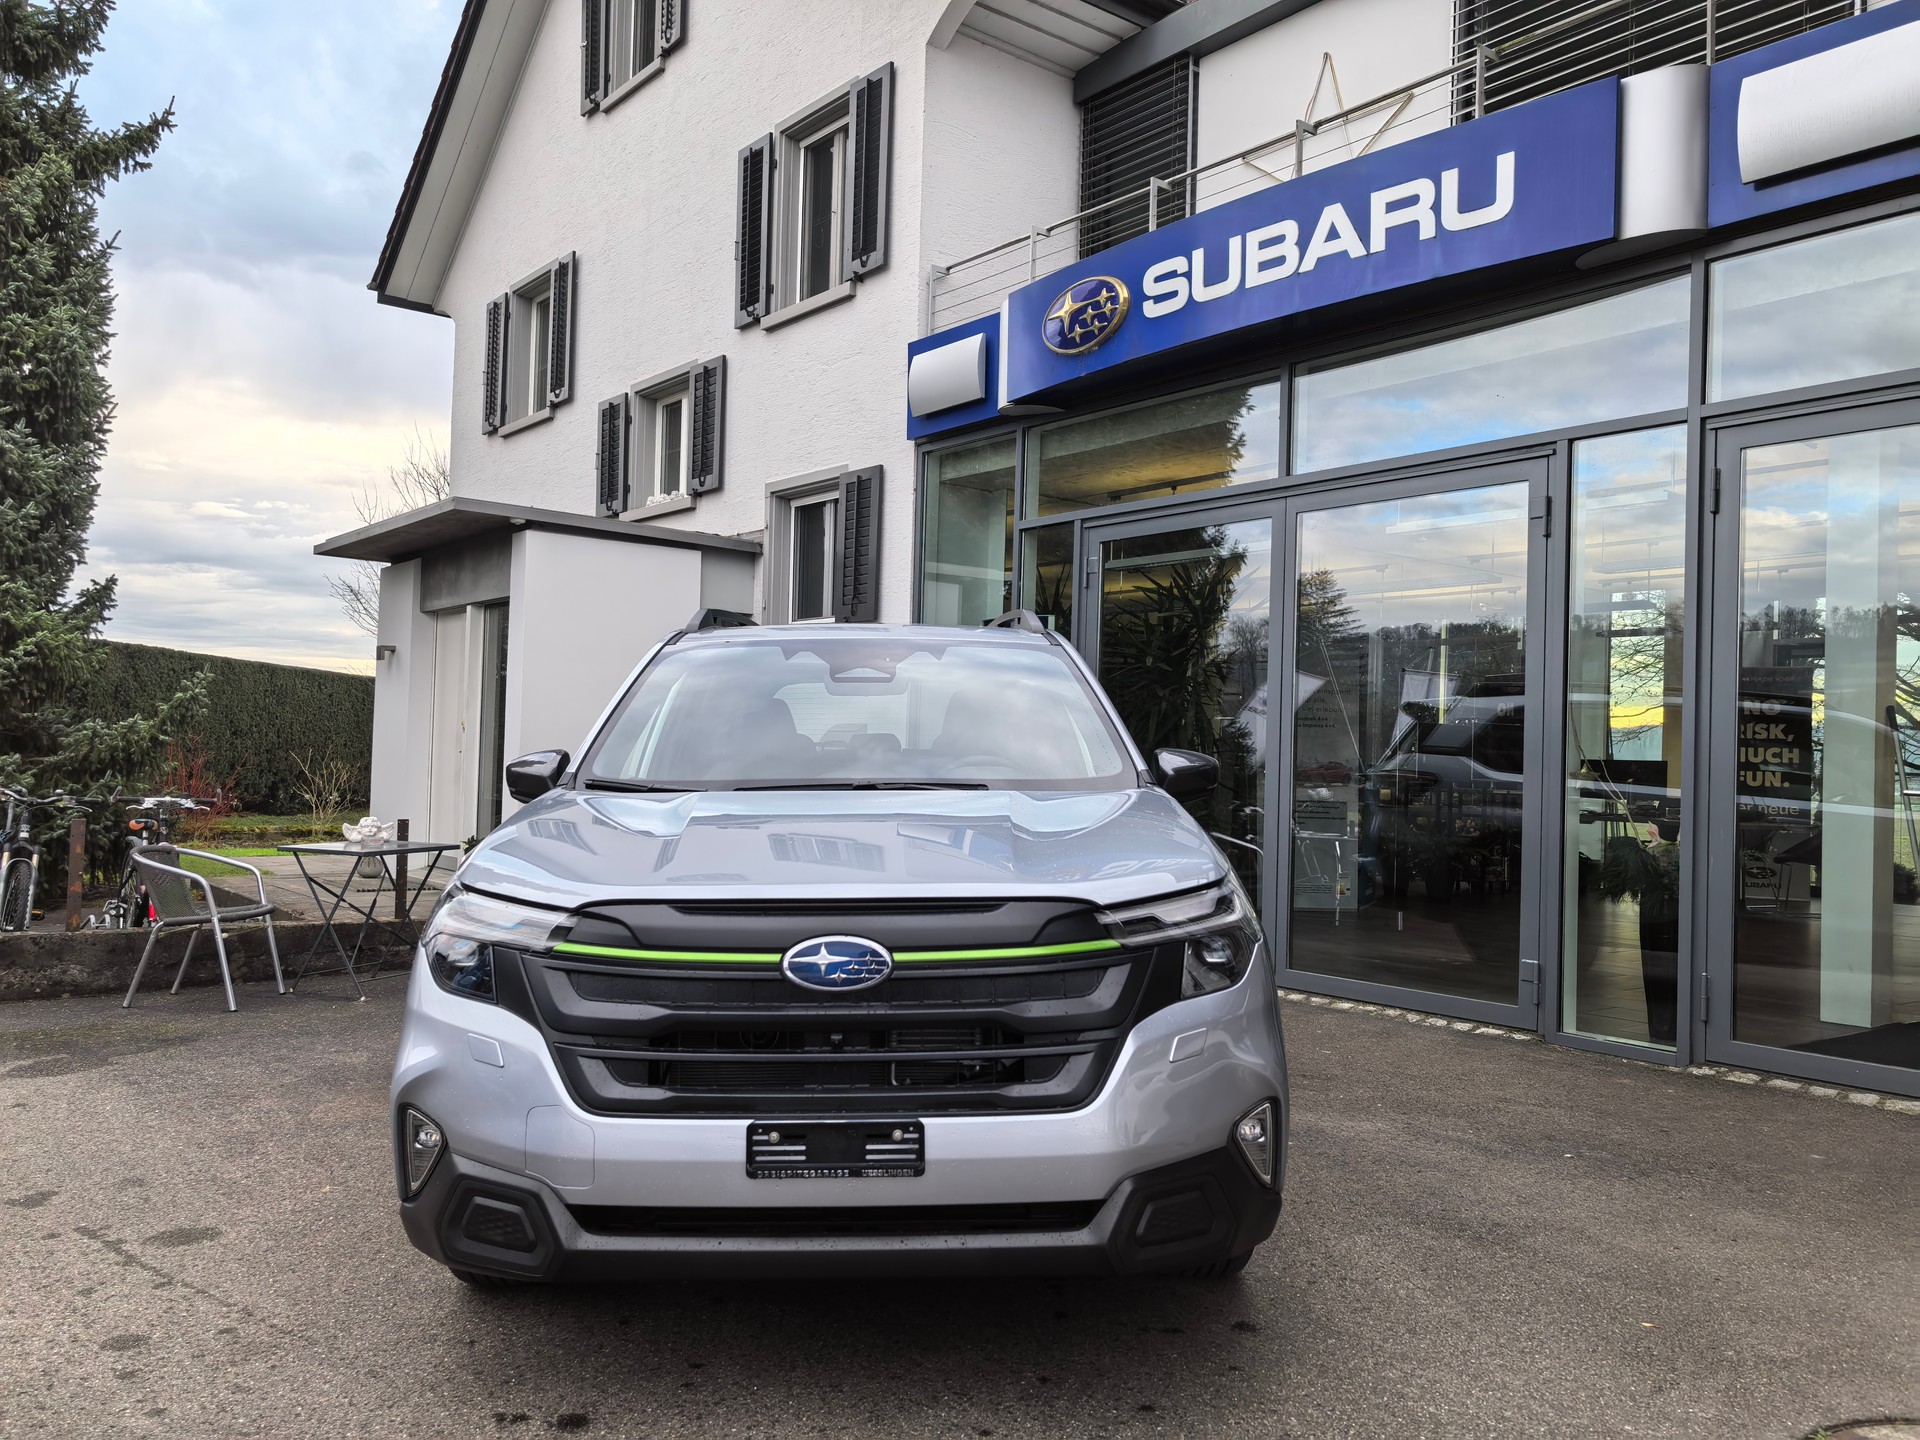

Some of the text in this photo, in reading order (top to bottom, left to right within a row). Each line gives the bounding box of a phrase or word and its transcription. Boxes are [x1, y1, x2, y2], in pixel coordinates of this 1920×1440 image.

[1142, 151, 1515, 319] SUBARU
[1743, 699, 1781, 716] NO
[1758, 803, 1800, 816] neue
